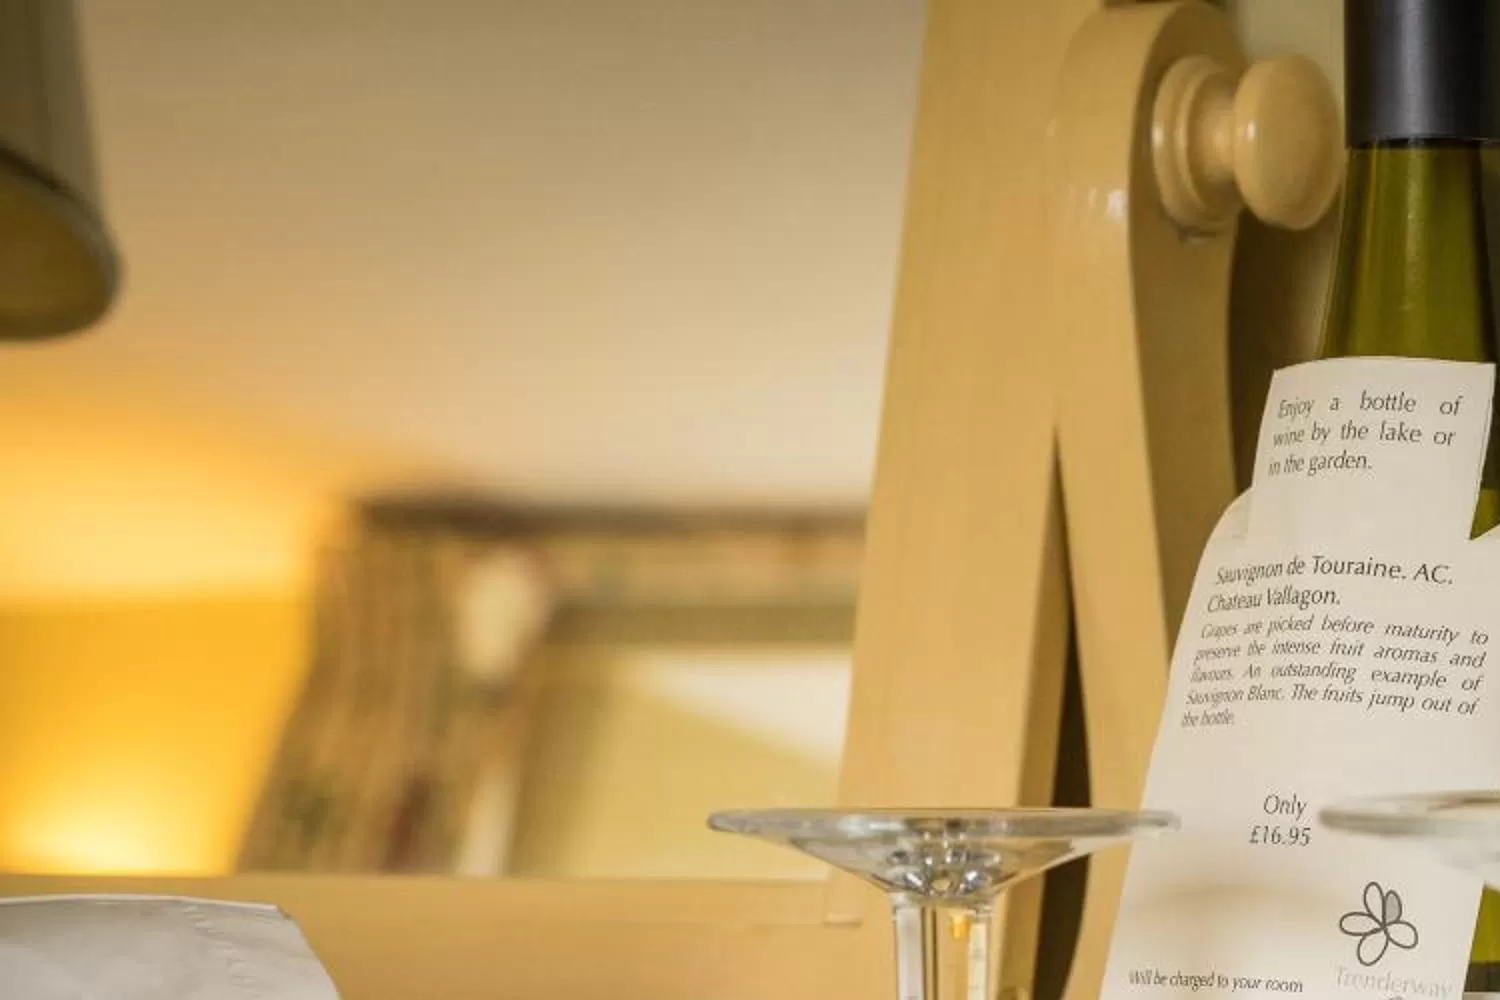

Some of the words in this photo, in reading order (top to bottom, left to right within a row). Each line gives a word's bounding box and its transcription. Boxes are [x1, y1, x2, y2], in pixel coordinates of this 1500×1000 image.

[1278, 398, 1314, 419] Enjoy
[1329, 398, 1339, 411] a
[1359, 391, 1416, 412] bottle
[1439, 393, 1463, 416] of
[1272, 428, 1305, 447] wine
[1311, 423, 1331, 444] by
[1340, 421, 1369, 441] the
[1379, 421, 1422, 444] lake
[1433, 431, 1456, 446] or
[1268, 457, 1280, 476] in
[1283, 452, 1305, 473] the
[1307, 451, 1372, 476] garden.
[1214, 561, 1283, 587] Sauvignon
[1287, 556, 1305, 576] de
[1311, 555, 1407, 580] Touraine.
[1412, 566, 1454, 585] AC.
[1207, 589, 1262, 613] Chateau
[1266, 585, 1341, 610] Vallagon.
[1201, 624, 1238, 638] Grapes
[1244, 620, 1263, 635] are
[1267, 614, 1315, 637] picked
[1321, 616, 1374, 635] before
[1384, 622, 1459, 647] maturity
[1470, 629, 1489, 645] to
[1248, 641, 1265, 656] the
[1272, 640, 1321, 654] intense
[1328, 641, 1364, 658] fruit
[1373, 644, 1438, 663] aromas
[1449, 652, 1487, 669] and
[1243, 664, 1261, 678] An
[1272, 662, 1357, 685] outstanding
[1370, 669, 1447, 690] example
[1461, 672, 1483, 691] of
[1186, 688, 1244, 708] Sauvignon
[1292, 683, 1318, 700] The
[1321, 685, 1364, 702] fruits
[1367, 691, 1415, 712] jump
[1421, 696, 1452, 712] out
[1457, 694, 1481, 715] of
[1182, 711, 1199, 728] the
[1263, 794, 1307, 821] Only
[1250, 826, 1311, 846] £16.95
[1128, 971, 1152, 985] Will
[1153, 973, 1166, 986] be
[1170, 972, 1214, 990] charged
[1217, 974, 1228, 987] to
[1232, 976, 1262, 990] your
[1265, 978, 1303, 992] room
